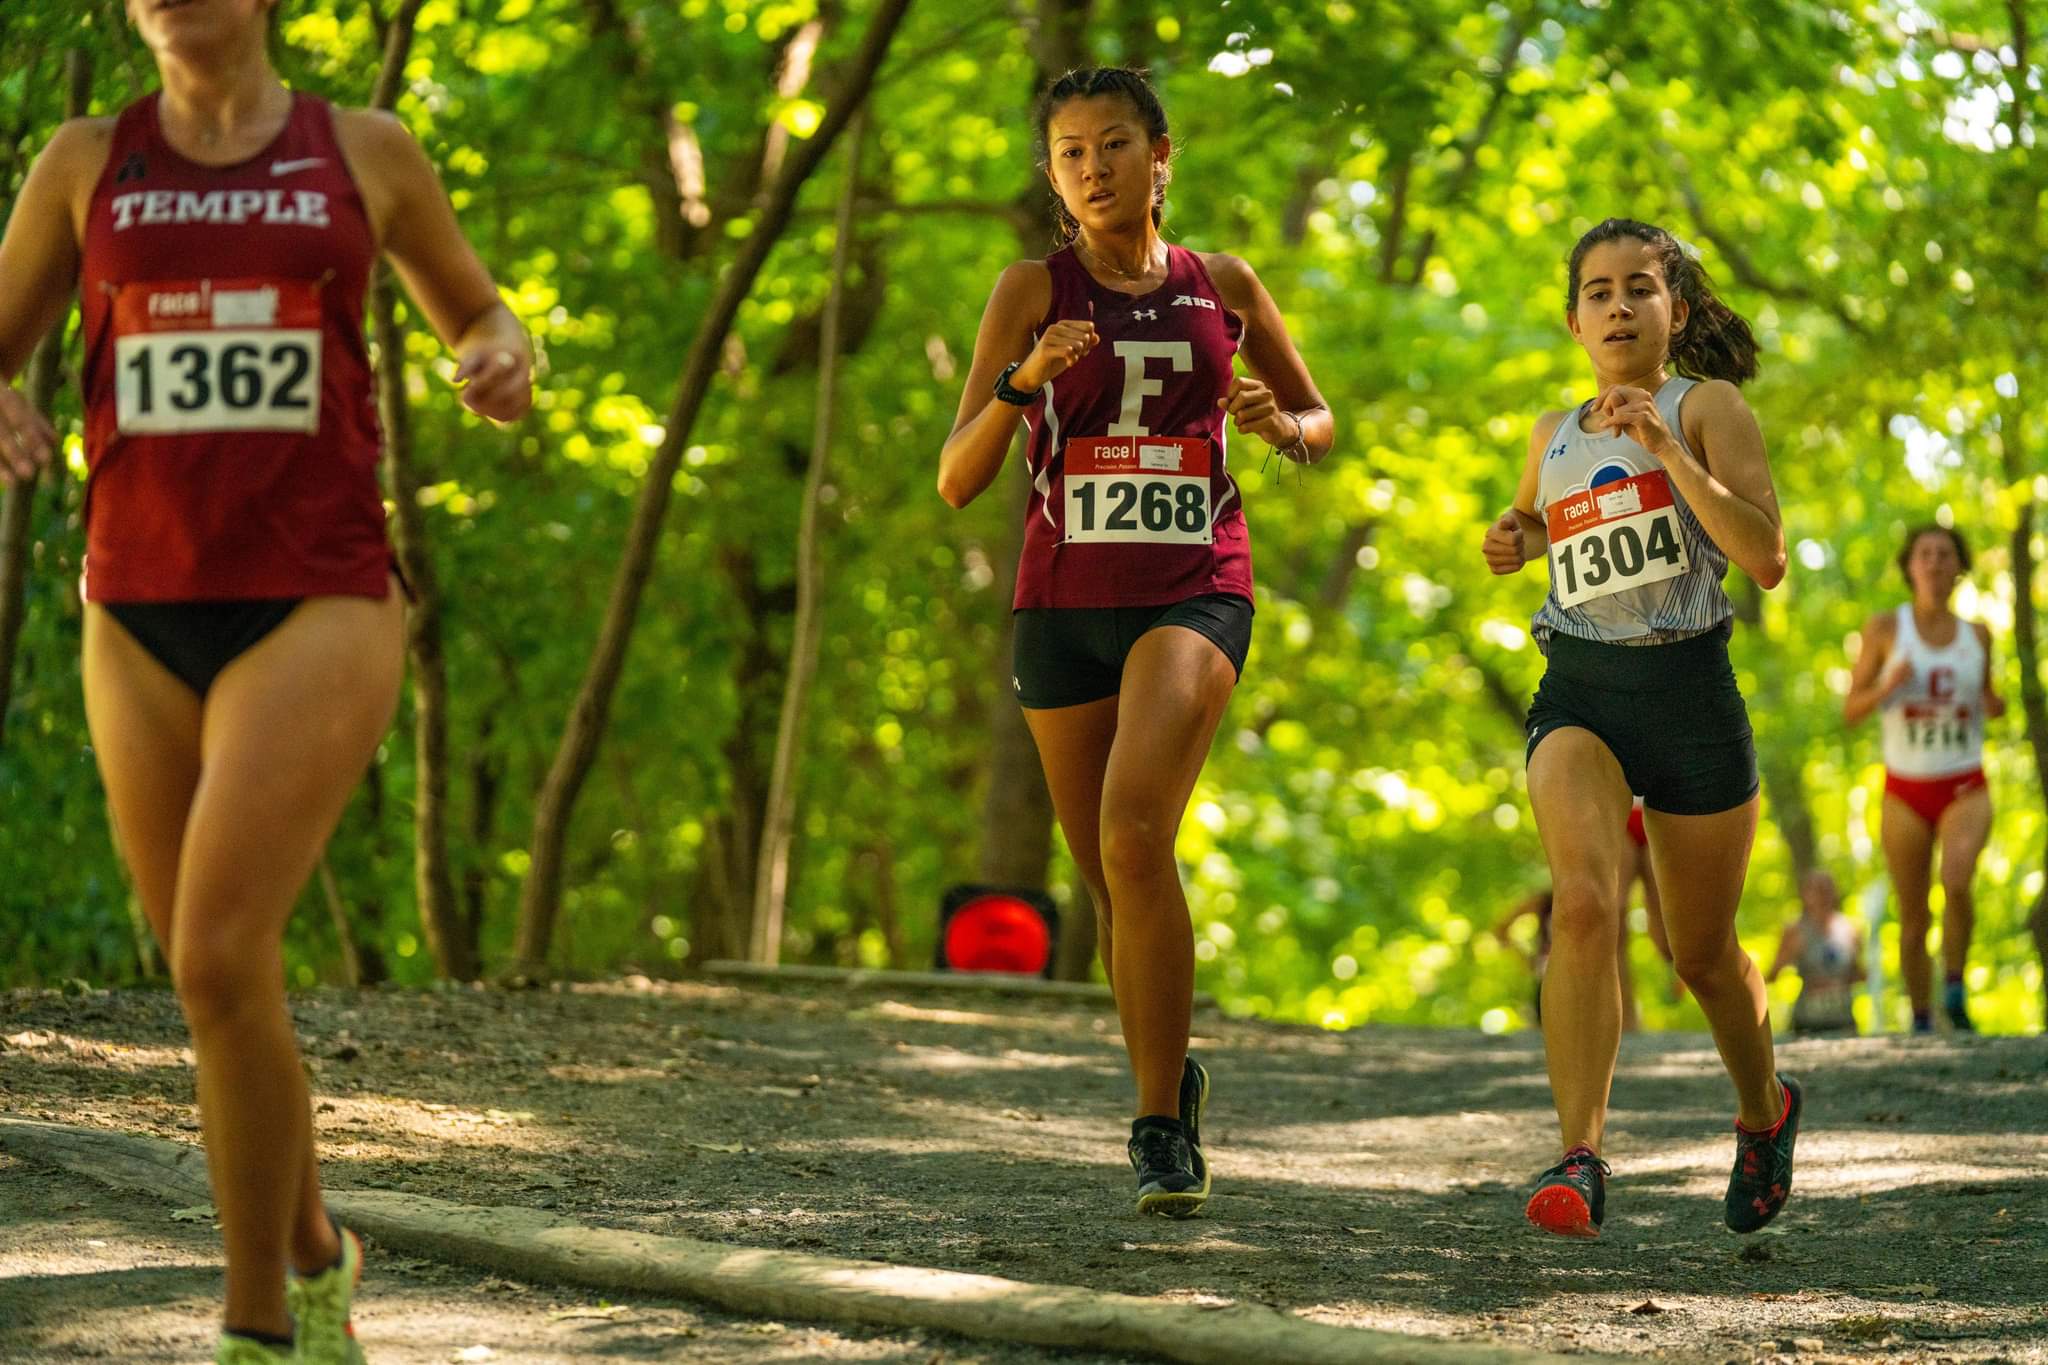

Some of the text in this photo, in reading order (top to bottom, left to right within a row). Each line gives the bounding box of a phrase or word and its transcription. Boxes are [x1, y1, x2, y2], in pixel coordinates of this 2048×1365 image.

[112, 191, 330, 231] TEMPLE
[148, 292, 199, 316] race
[128, 342, 310, 414] 1362
[1107, 341, 1193, 436] F
[1094, 445, 1130, 459] race
[1072, 481, 1207, 533] 1268
[1564, 501, 1589, 520] race
[1558, 515, 1681, 594] 1304
[1929, 666, 1956, 704] C
